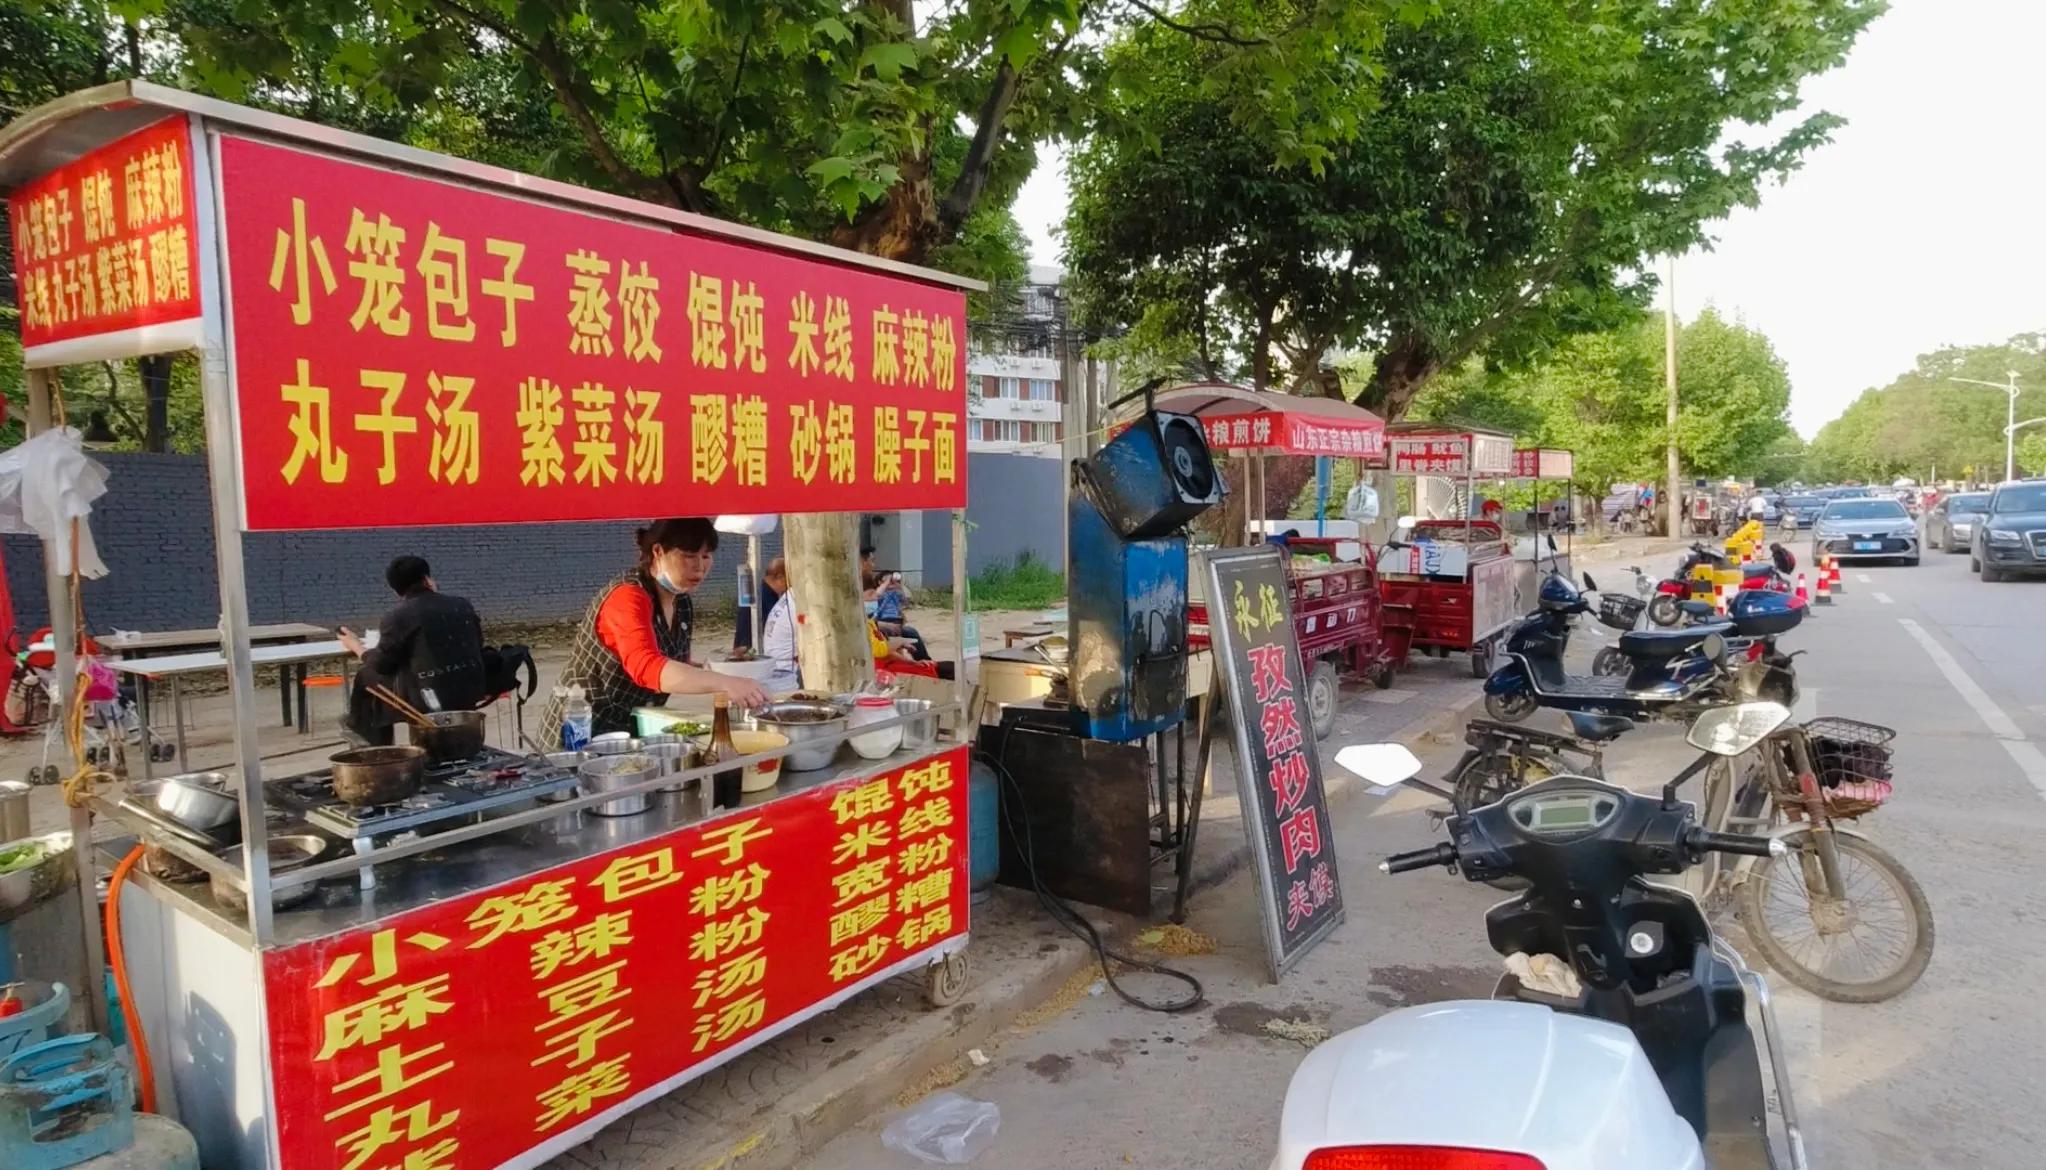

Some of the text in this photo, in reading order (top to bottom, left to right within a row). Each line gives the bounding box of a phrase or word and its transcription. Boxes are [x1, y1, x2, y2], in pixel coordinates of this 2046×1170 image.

[18, 140, 184, 265] 小笼包子 馄饨 麻辣粉
[24, 223, 190, 331] 米线 丸子汤 紫菜汤 醪糟
[268, 197, 957, 391] 小笼包子 蒸饺 馄饨 米线 麻辣粉
[280, 358, 957, 488] 丸子汤 紫菜汤 醪糟 砂锅 臊子面
[829, 759, 954, 825] 馄饨
[1247, 642, 1321, 876] 孜然炒肉
[830, 796, 954, 866] 米线
[831, 832, 954, 908] 宽粉
[828, 903, 953, 983] 砂锅
[829, 866, 954, 948] 醪糟
